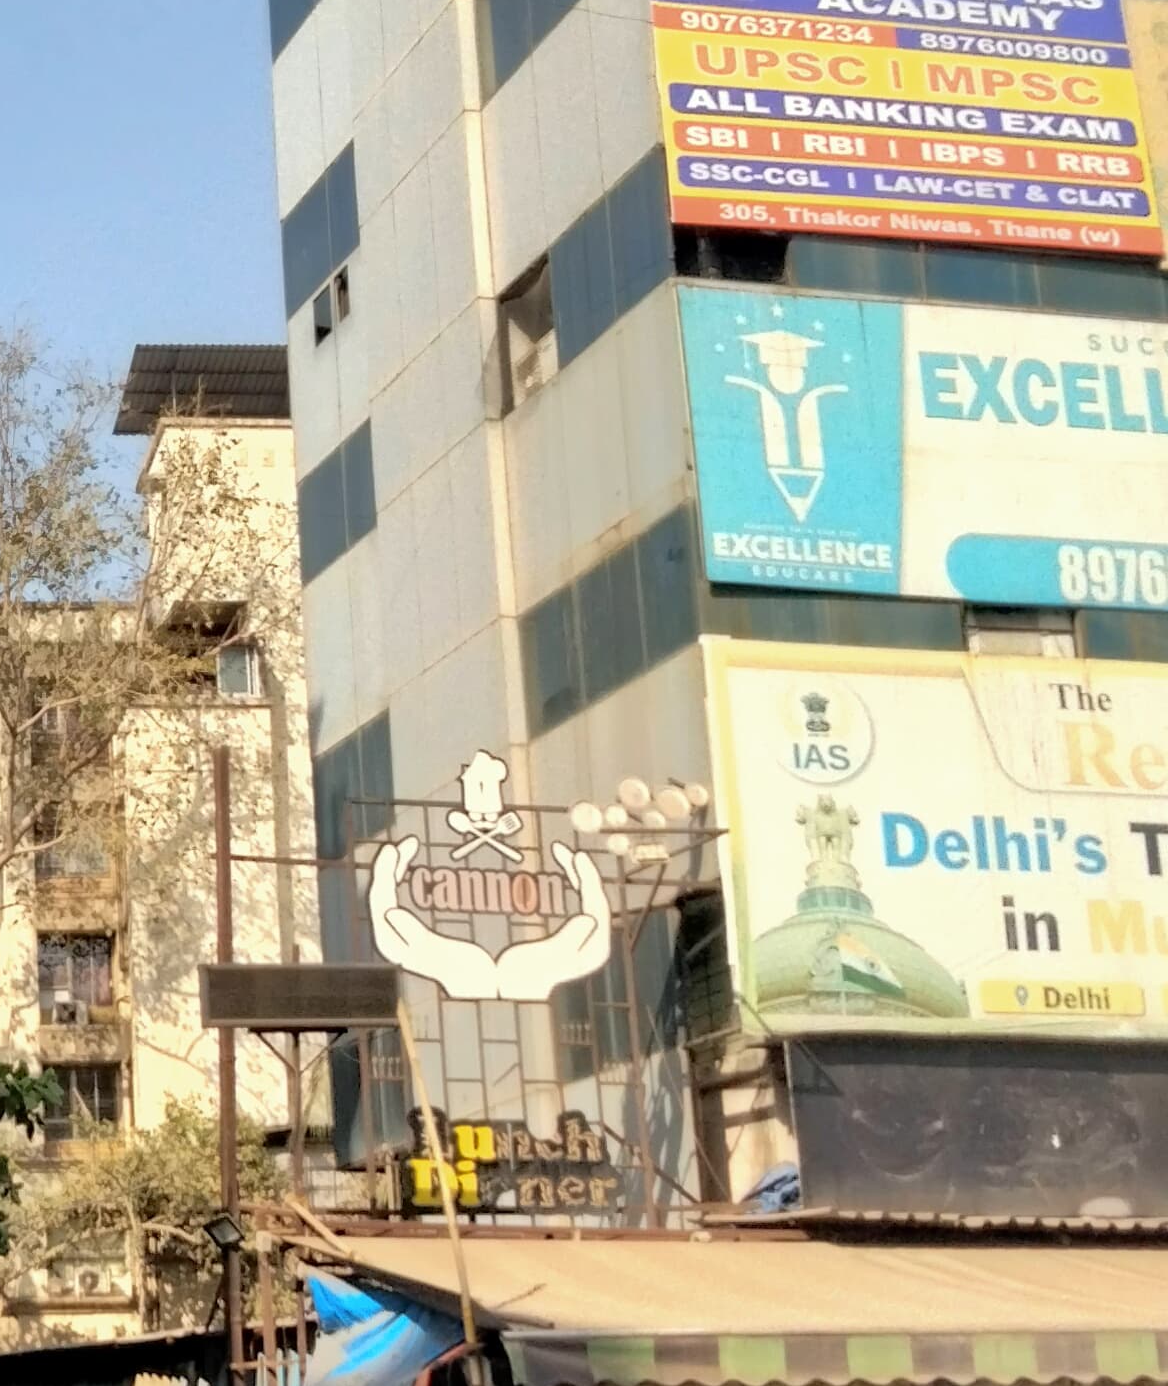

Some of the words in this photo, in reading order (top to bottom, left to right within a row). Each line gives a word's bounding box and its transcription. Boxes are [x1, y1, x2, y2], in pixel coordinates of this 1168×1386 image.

[681, 11, 873, 44] 9076371234
[695, 43, 868, 87] UPSC
[926, 63, 1101, 106] MPSC
[686, 88, 772, 114] ALL
[783, 94, 987, 130] BANKING
[1000, 112, 1122, 142] EXAM
[686, 125, 749, 149] SBI
[803, 133, 866, 157] RBI
[920, 142, 1006, 167] IBPS
[1056, 152, 1131, 177] RRB
[689, 162, 830, 188] SSC-CGL
[874, 173, 1015, 201] LAW-CET
[1057, 187, 1136, 210] CLAT
[719, 203, 777, 225] 305,
[783, 206, 881, 229] Thakor
[889, 212, 982, 237] Niwas,
[987, 218, 1072, 241] Thane
[712, 532, 893, 568] EXCELLENCE
[1049, 683, 1113, 712] The
[792, 743, 851, 771] IAS
[410, 865, 568, 915] cannon
[1002, 895, 1061, 952] in
[1043, 986, 1112, 1010] Delhi
